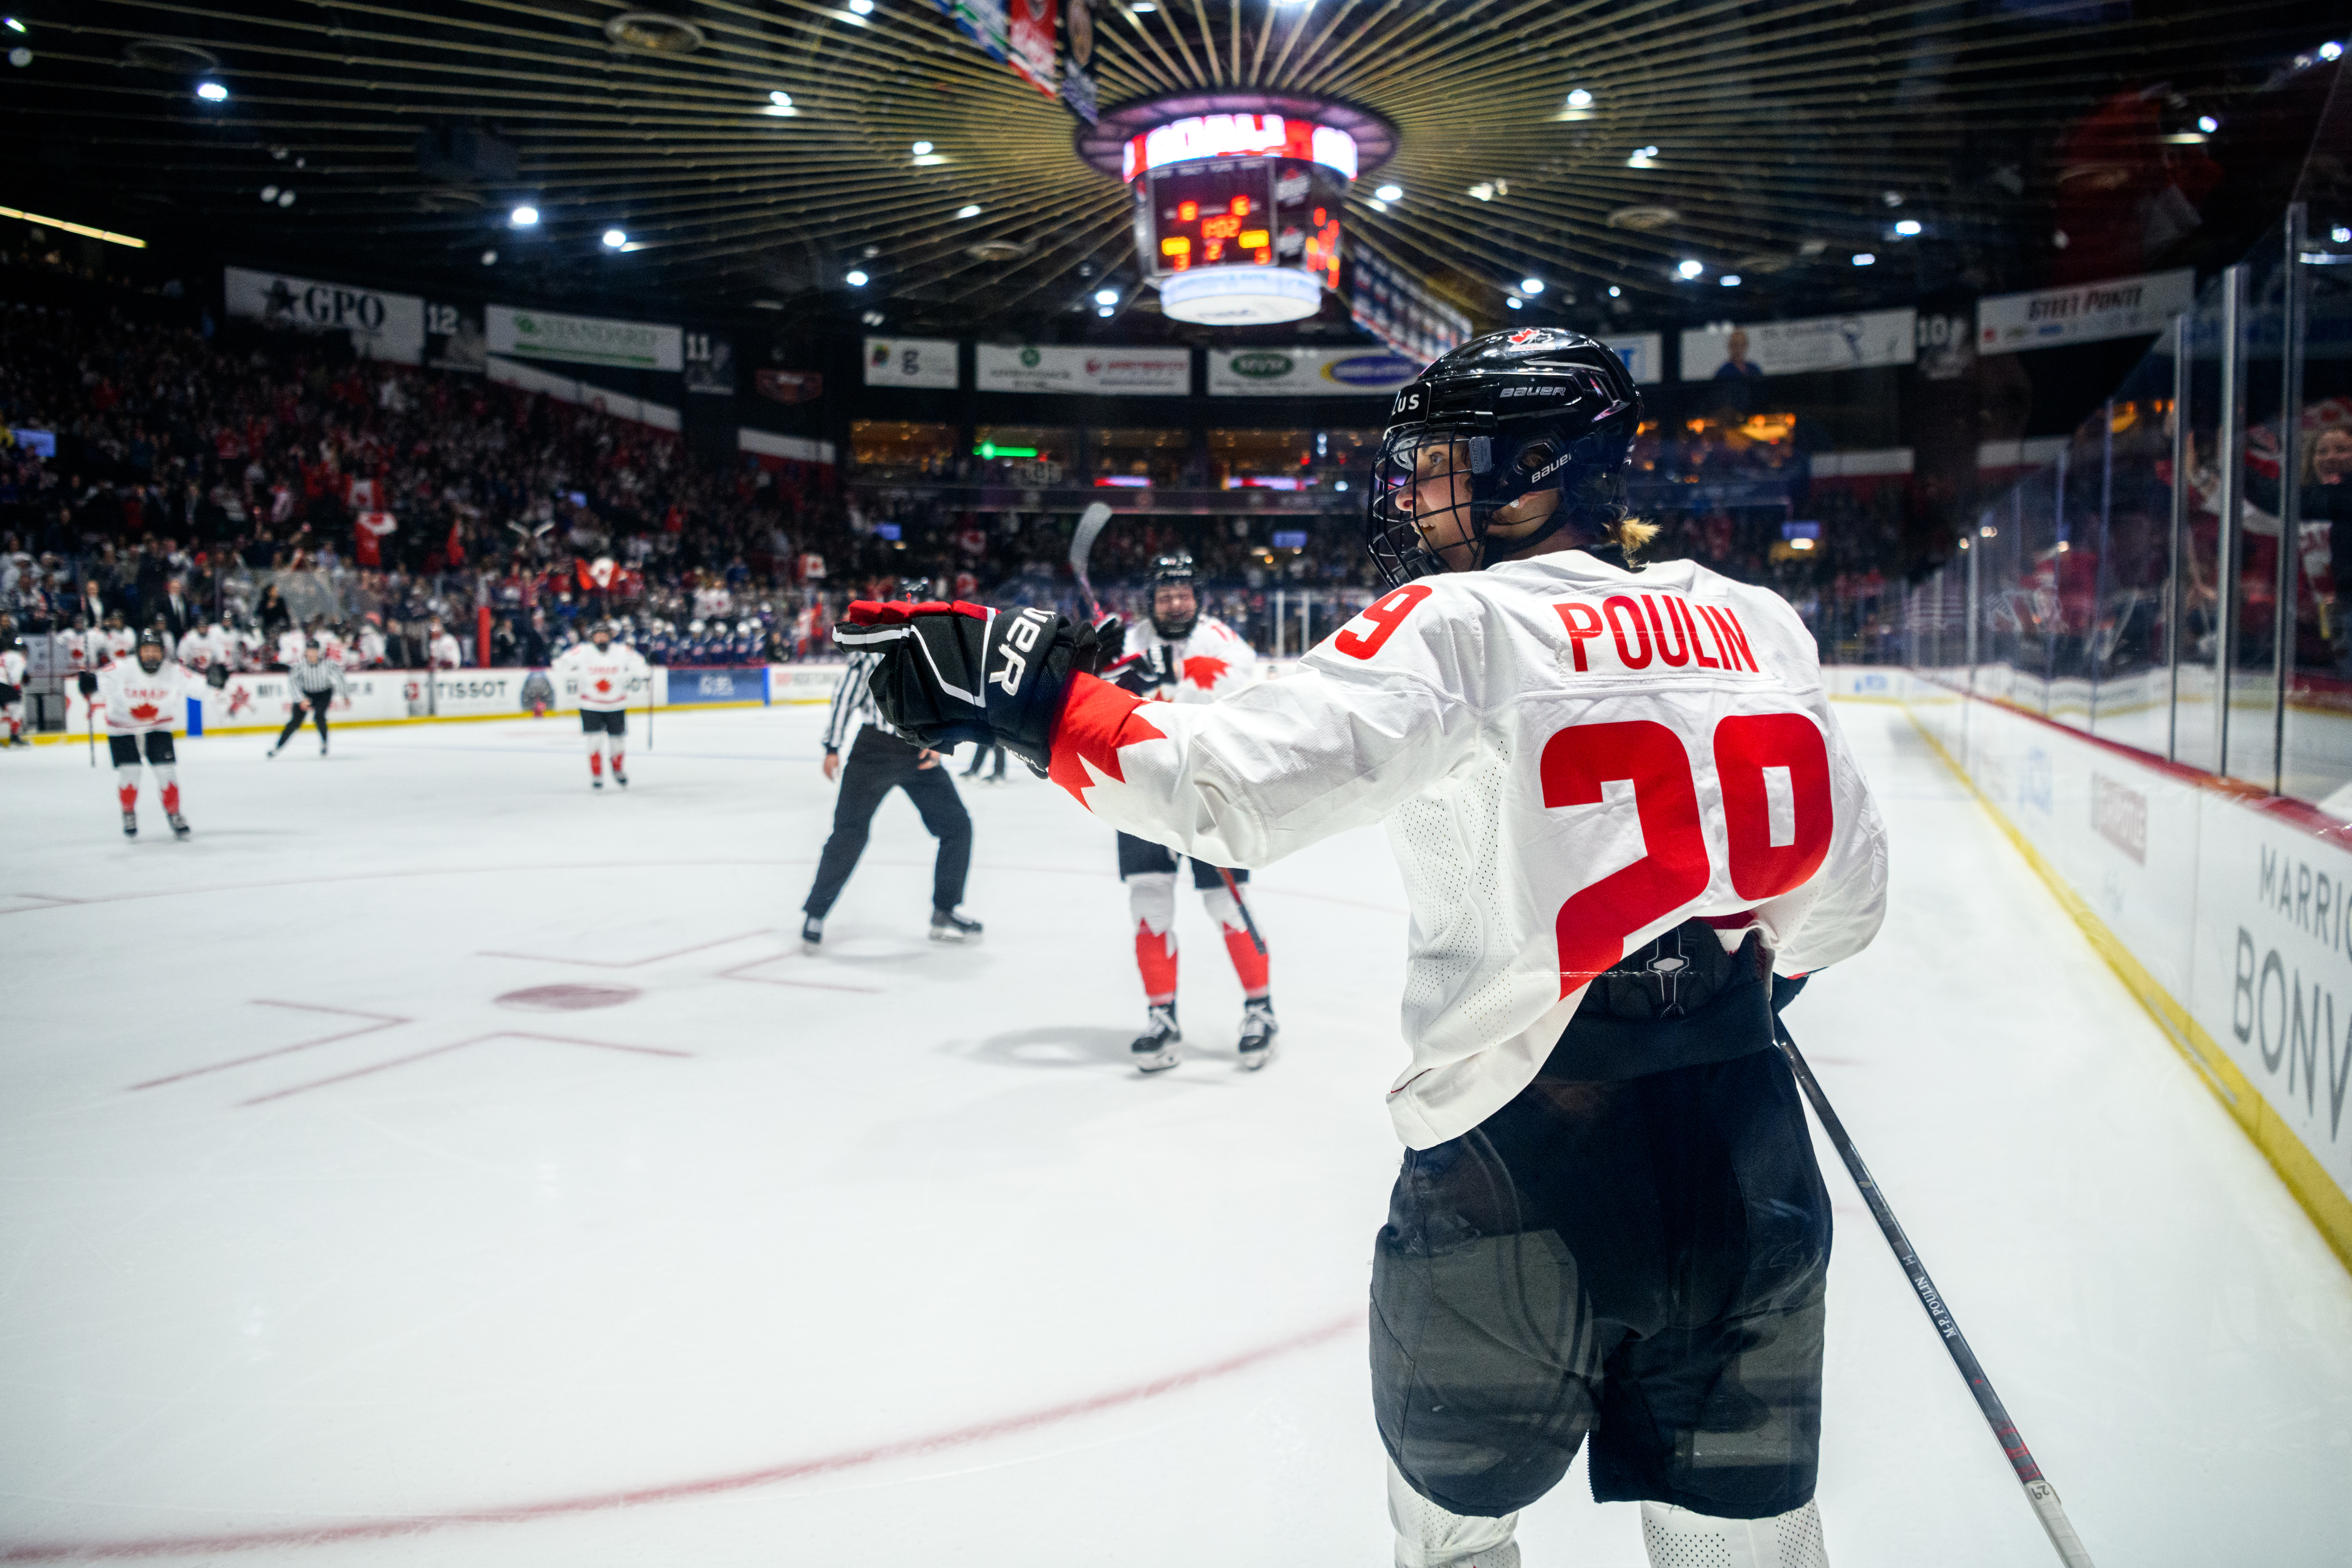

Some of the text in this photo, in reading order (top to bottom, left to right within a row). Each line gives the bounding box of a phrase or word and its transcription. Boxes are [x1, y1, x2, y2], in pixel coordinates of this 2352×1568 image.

[304, 285, 385, 330] GPO
[428, 305, 458, 334] 12
[1392, 394, 1419, 416] US
[1500, 387, 1566, 397] BAUER
[1333, 584, 1433, 660] 9
[1552, 594, 1760, 673] POULIN
[439, 680, 508, 698] TISSOT
[2260, 843, 2352, 962] MARRI
[1915, 1276, 1957, 1338] M-P. POULIN
[2031, 1485, 2050, 1500] 29
